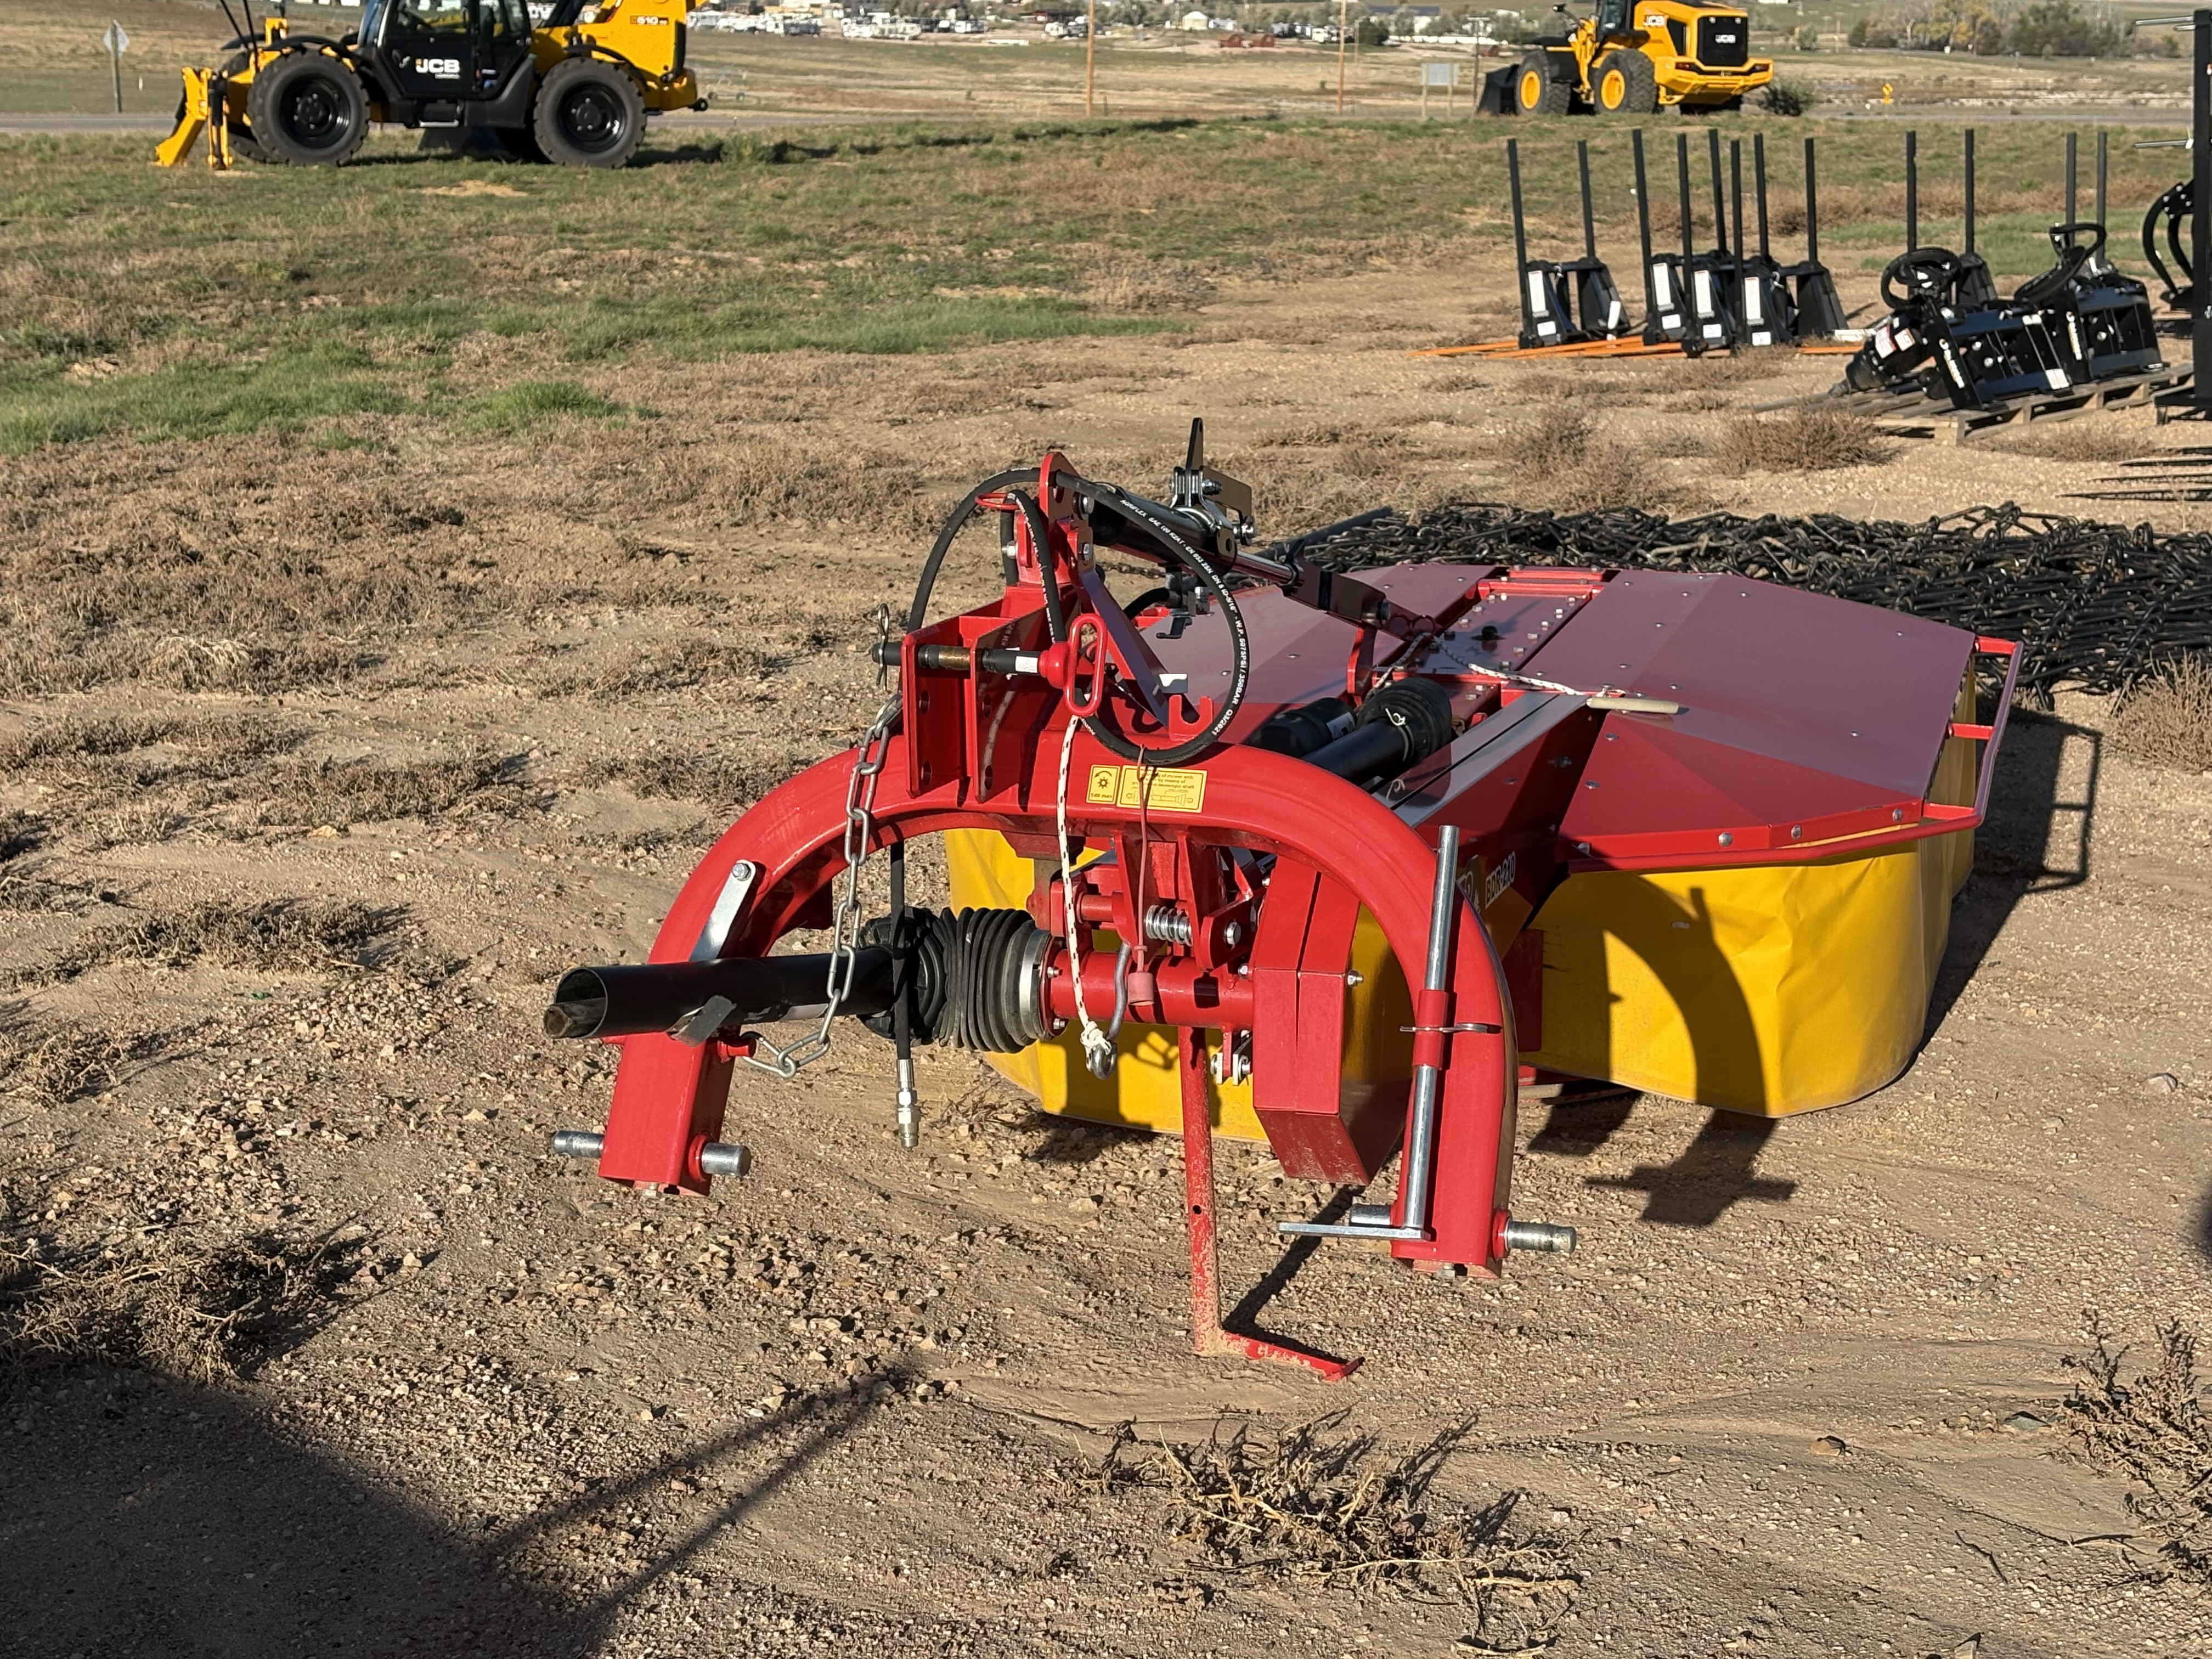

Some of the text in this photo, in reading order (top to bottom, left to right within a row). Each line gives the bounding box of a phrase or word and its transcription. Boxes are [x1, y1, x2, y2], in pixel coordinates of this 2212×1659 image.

[415, 58, 460, 73] JCB
[1185, 546, 1195, 555] EN
[1200, 562, 1214, 574] 2SN
[1211, 574, 1222, 584] DN
[1486, 852, 1515, 909] BDR-210
